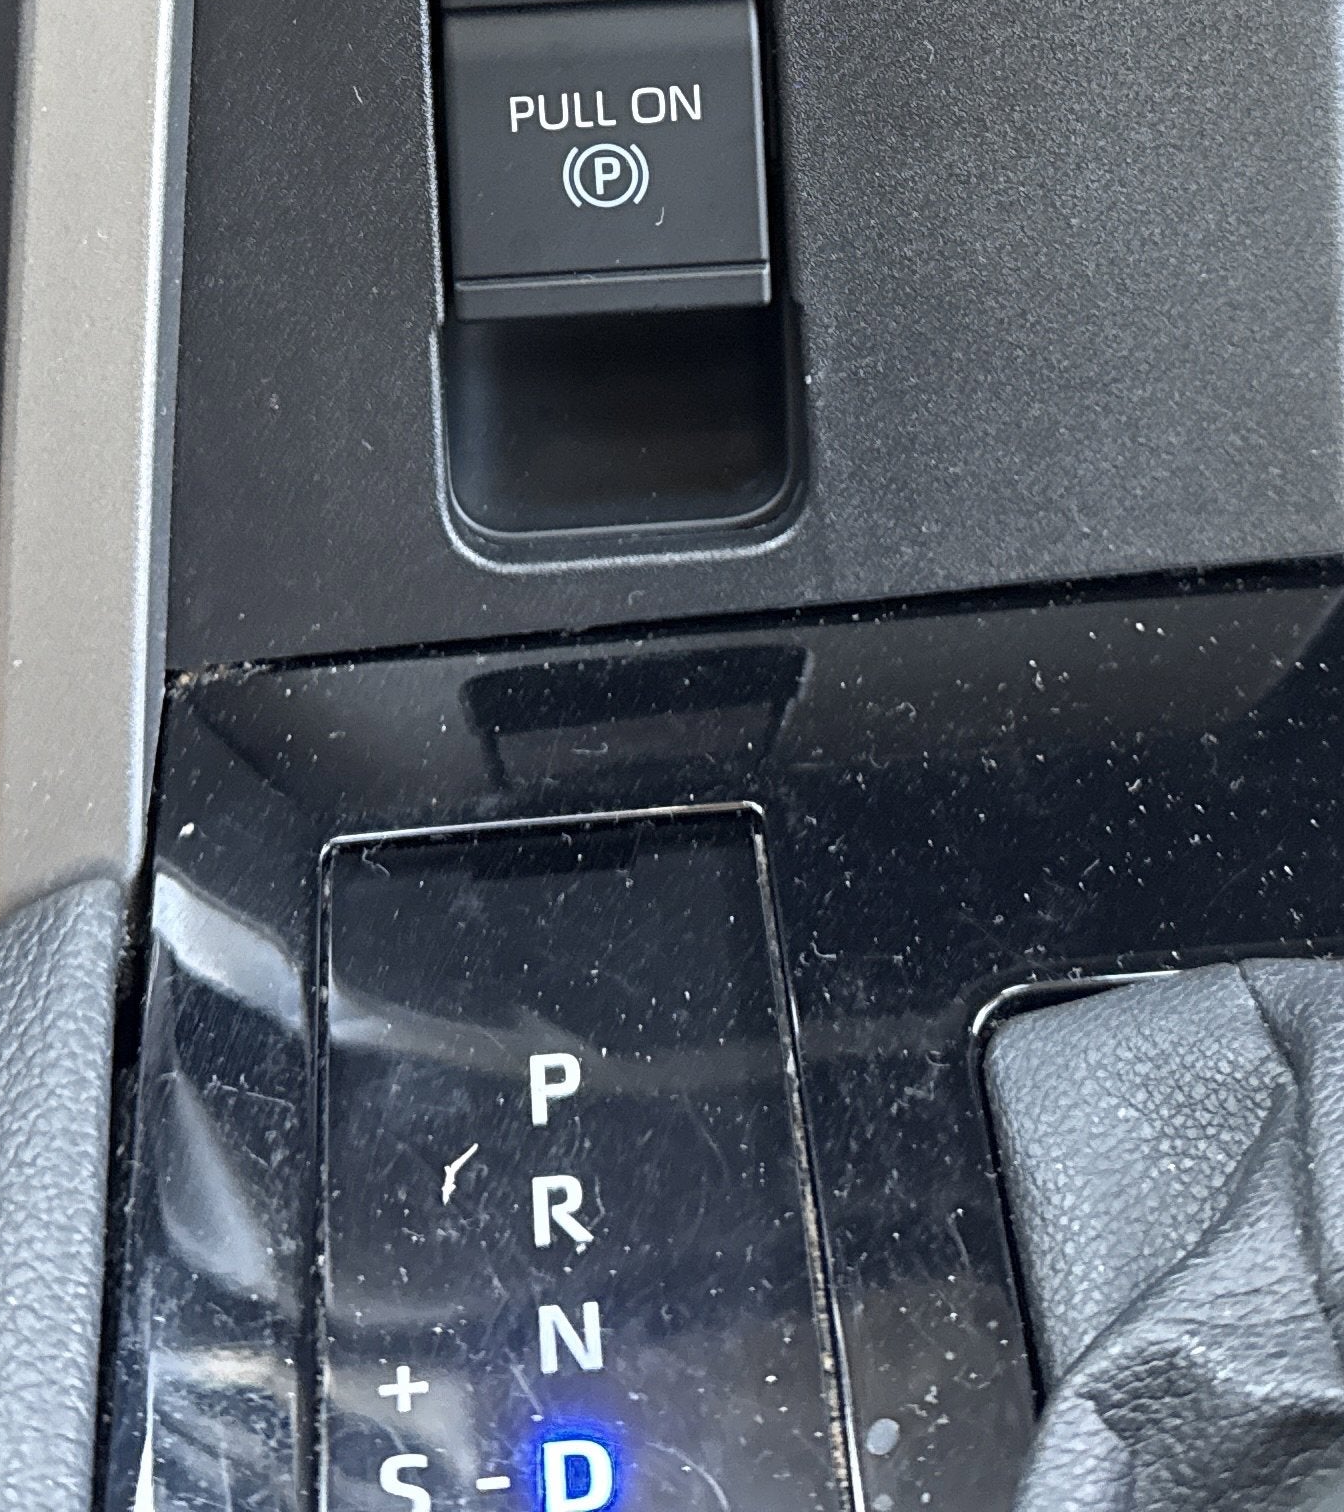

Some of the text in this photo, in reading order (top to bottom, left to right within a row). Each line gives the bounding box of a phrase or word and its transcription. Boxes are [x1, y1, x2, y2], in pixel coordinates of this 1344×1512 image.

[509, 83, 703, 133] PULL ON
[593, 156, 621, 195] P
[529, 1052, 581, 1126] P
[531, 1174, 594, 1248] R
[537, 1301, 604, 1375] N
[379, 1453, 432, 1512] S
[542, 1439, 614, 1512] D
